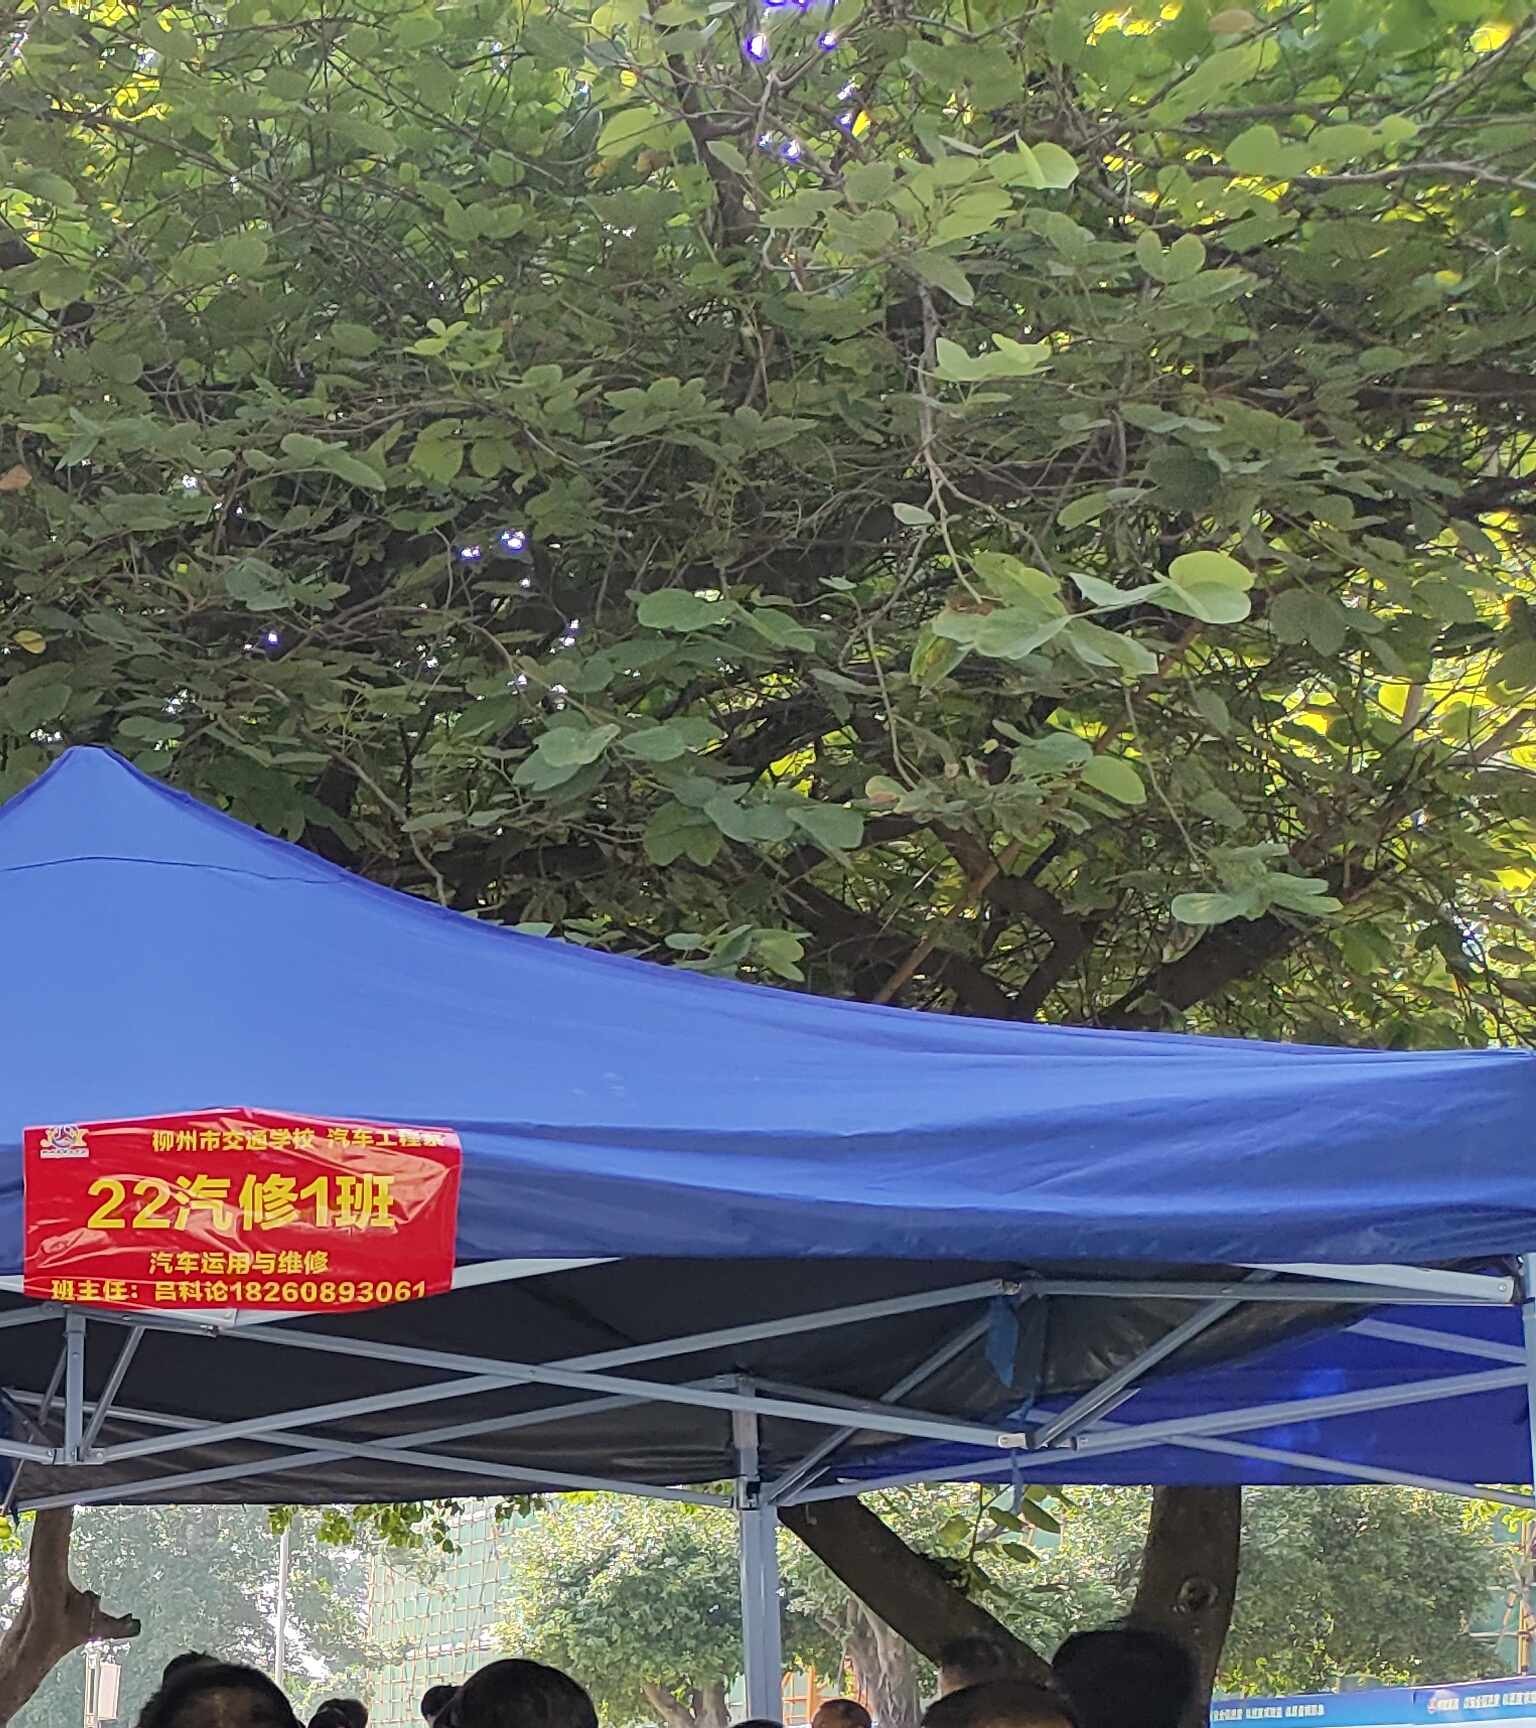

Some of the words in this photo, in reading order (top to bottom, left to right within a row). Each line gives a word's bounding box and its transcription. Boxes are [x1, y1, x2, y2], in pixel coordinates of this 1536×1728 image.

[152, 1127, 315, 1153] 柳州市交通学校
[327, 1127, 445, 1149] 汽车工程系
[87, 1173, 396, 1231] 22汽修1班
[149, 1249, 329, 1275] 汽车运用与维修
